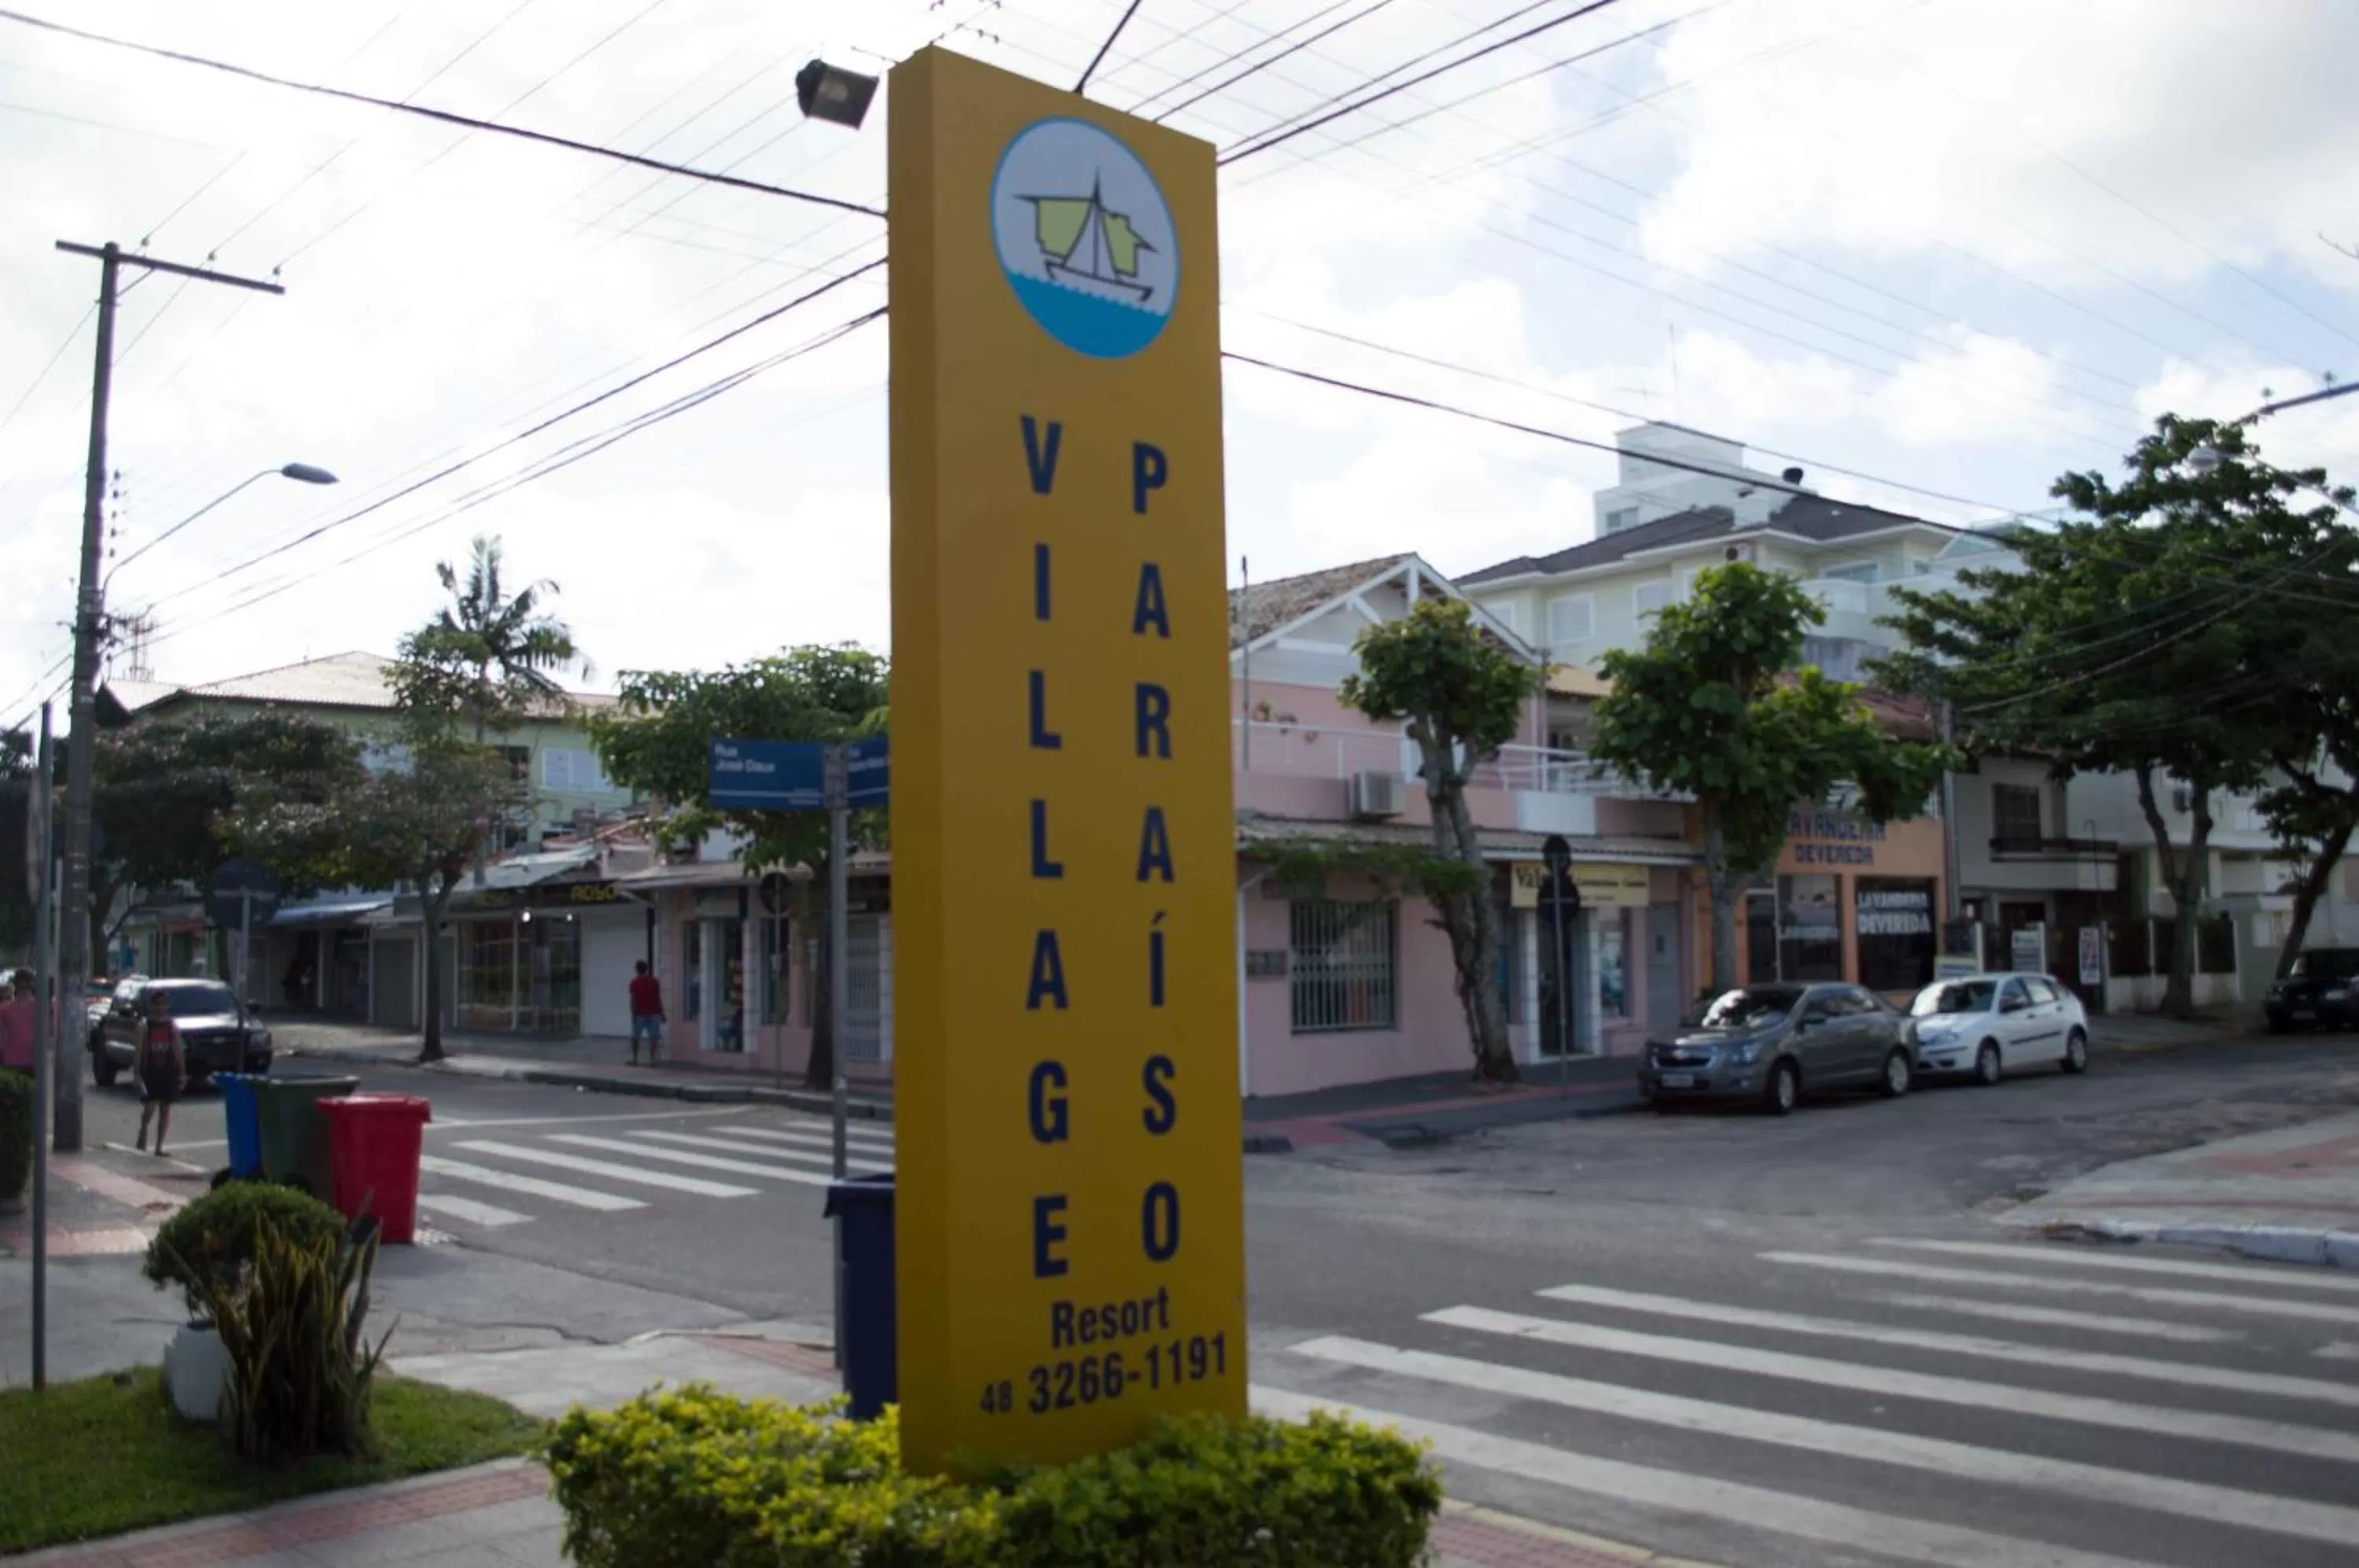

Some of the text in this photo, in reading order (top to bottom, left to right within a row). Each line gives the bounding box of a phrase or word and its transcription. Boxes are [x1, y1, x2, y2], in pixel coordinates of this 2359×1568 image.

[1020, 414, 1069, 1279] VILLAGE
[1132, 441, 1180, 1263] PARAÍSO
[981, 1331, 1226, 1414] 48 3266-1191
[1052, 1286, 1169, 1349] Resort
